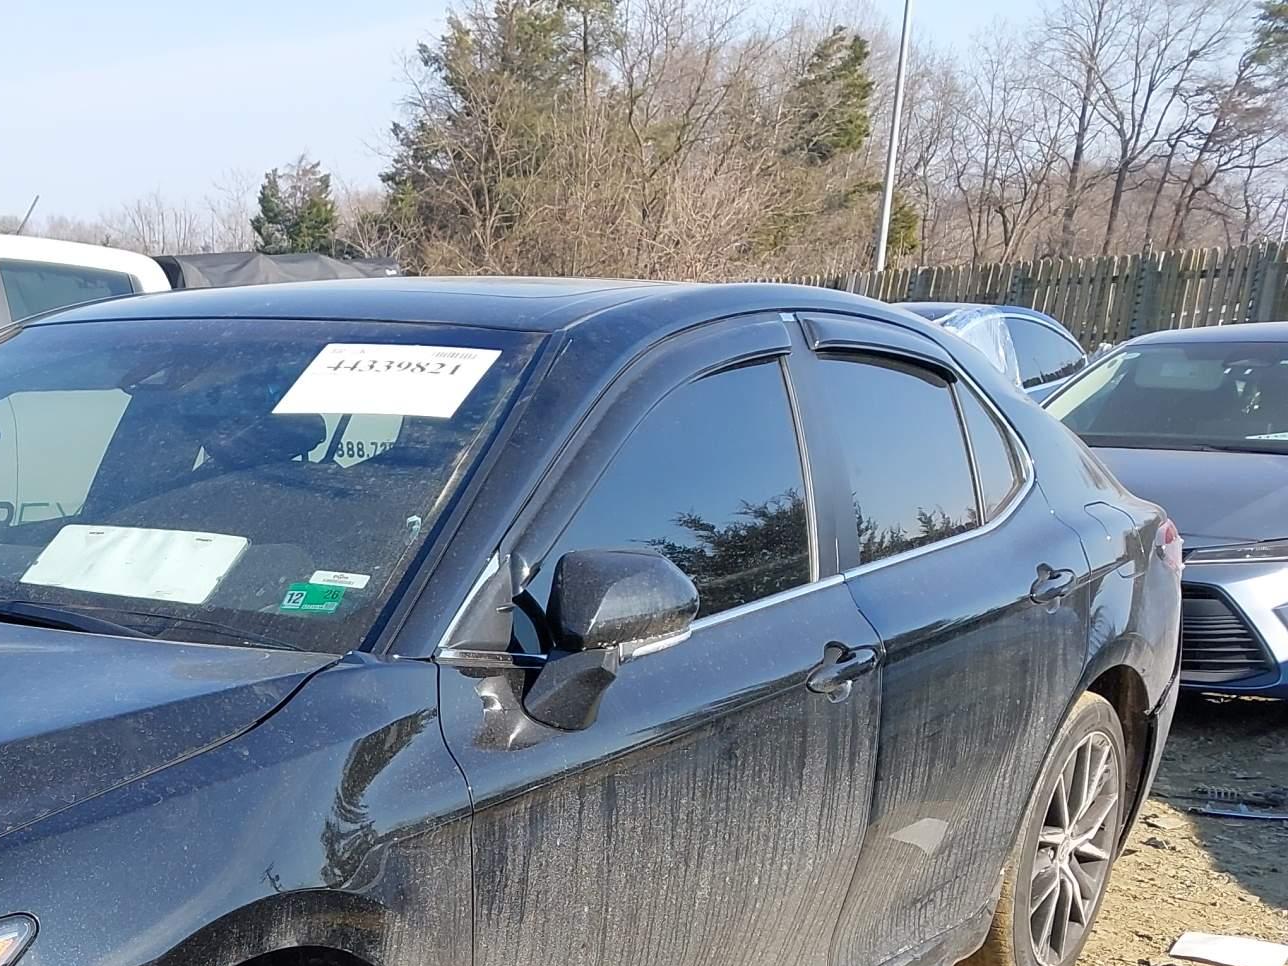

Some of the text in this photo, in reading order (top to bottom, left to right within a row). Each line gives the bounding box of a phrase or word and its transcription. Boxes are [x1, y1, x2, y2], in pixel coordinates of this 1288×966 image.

[326, 359, 462, 376] 44339821
[287, 589, 340, 605] 12 26
